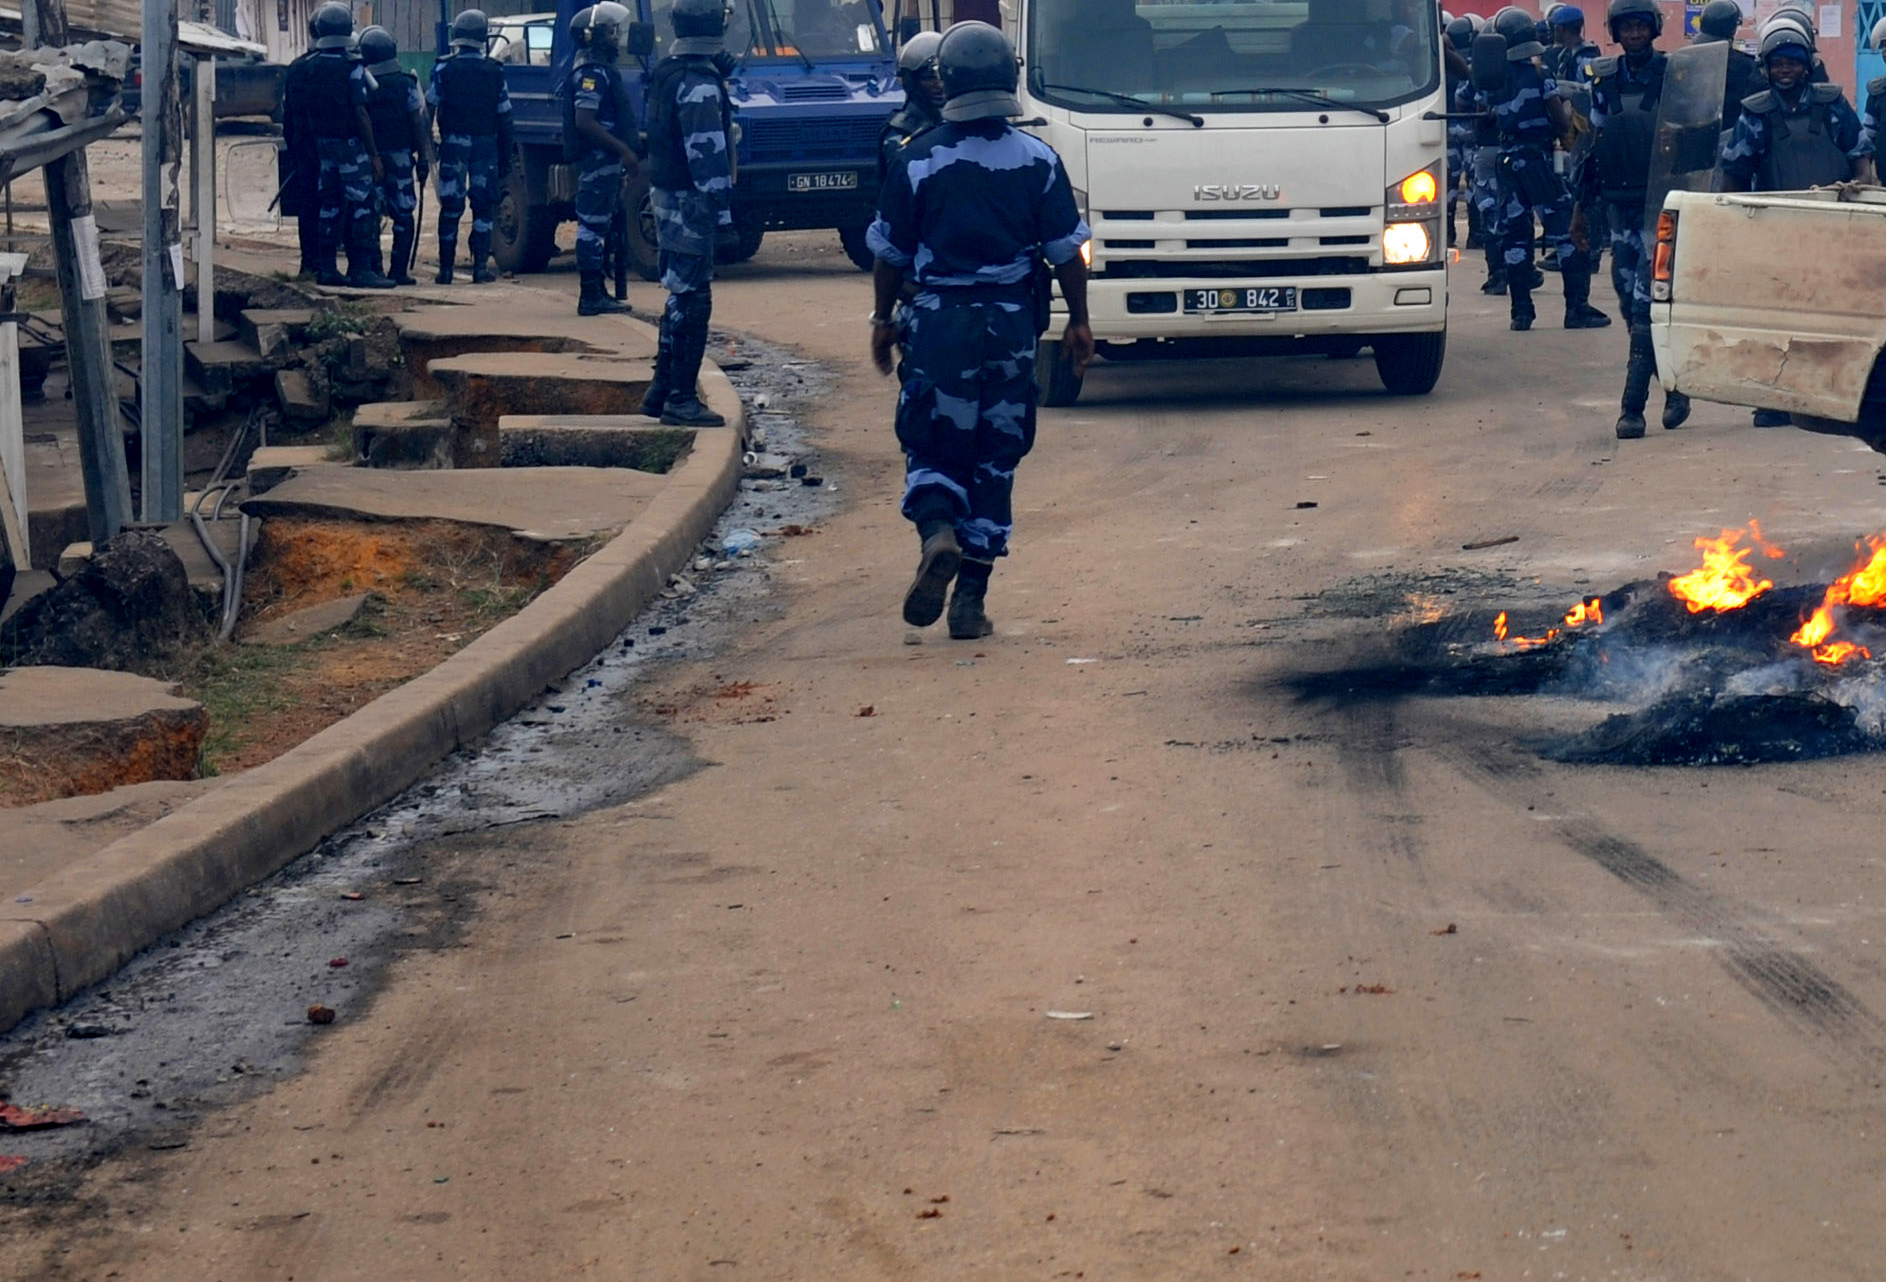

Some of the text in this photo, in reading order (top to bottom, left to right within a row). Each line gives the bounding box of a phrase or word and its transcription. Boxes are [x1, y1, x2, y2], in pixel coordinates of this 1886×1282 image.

[797, 176, 810, 188] GN
[1194, 184, 1280, 201] ISUZU
[1196, 290, 1219, 308] 30
[1246, 289, 1279, 307] 842
